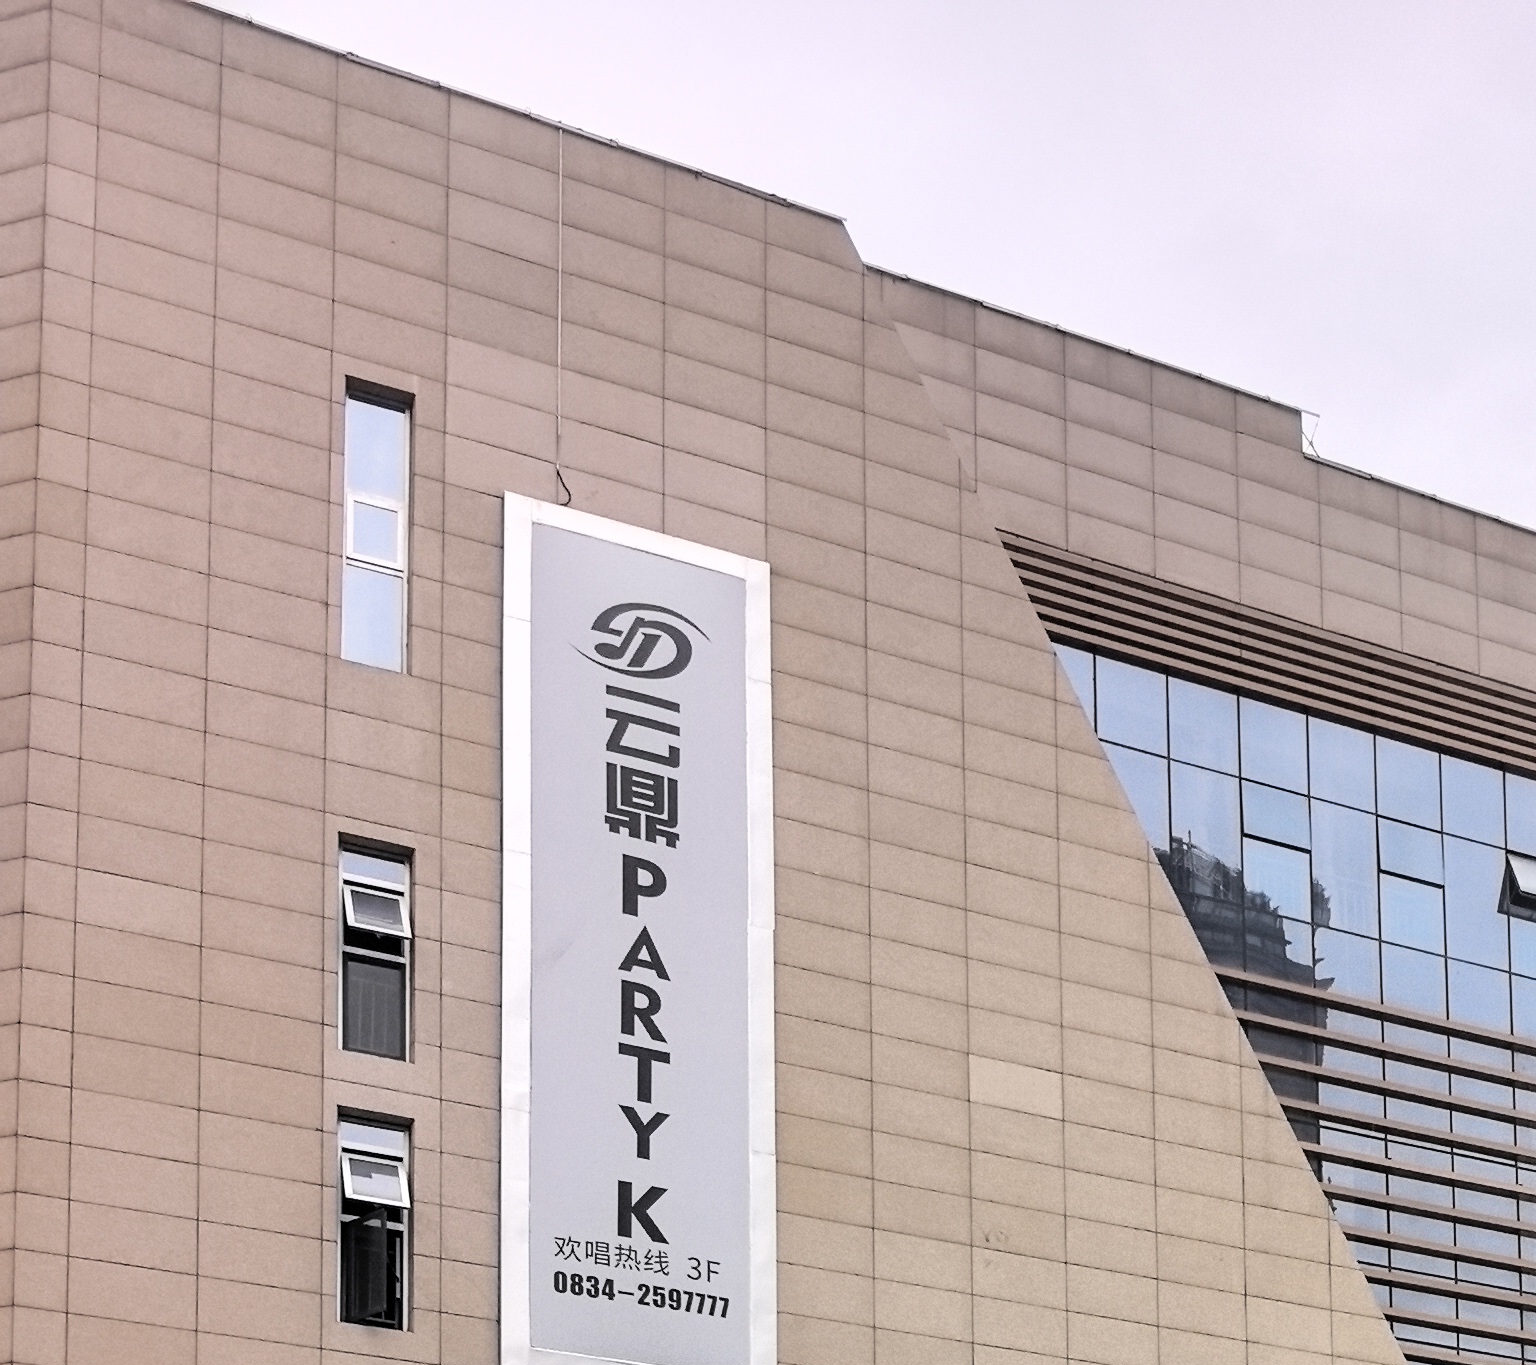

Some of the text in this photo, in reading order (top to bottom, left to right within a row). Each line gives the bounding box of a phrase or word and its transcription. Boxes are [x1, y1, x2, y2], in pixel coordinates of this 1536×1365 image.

[605, 683, 681, 1245] 云鼎 PARTY K
[553, 1235, 721, 1283] 欢唱热线 3F
